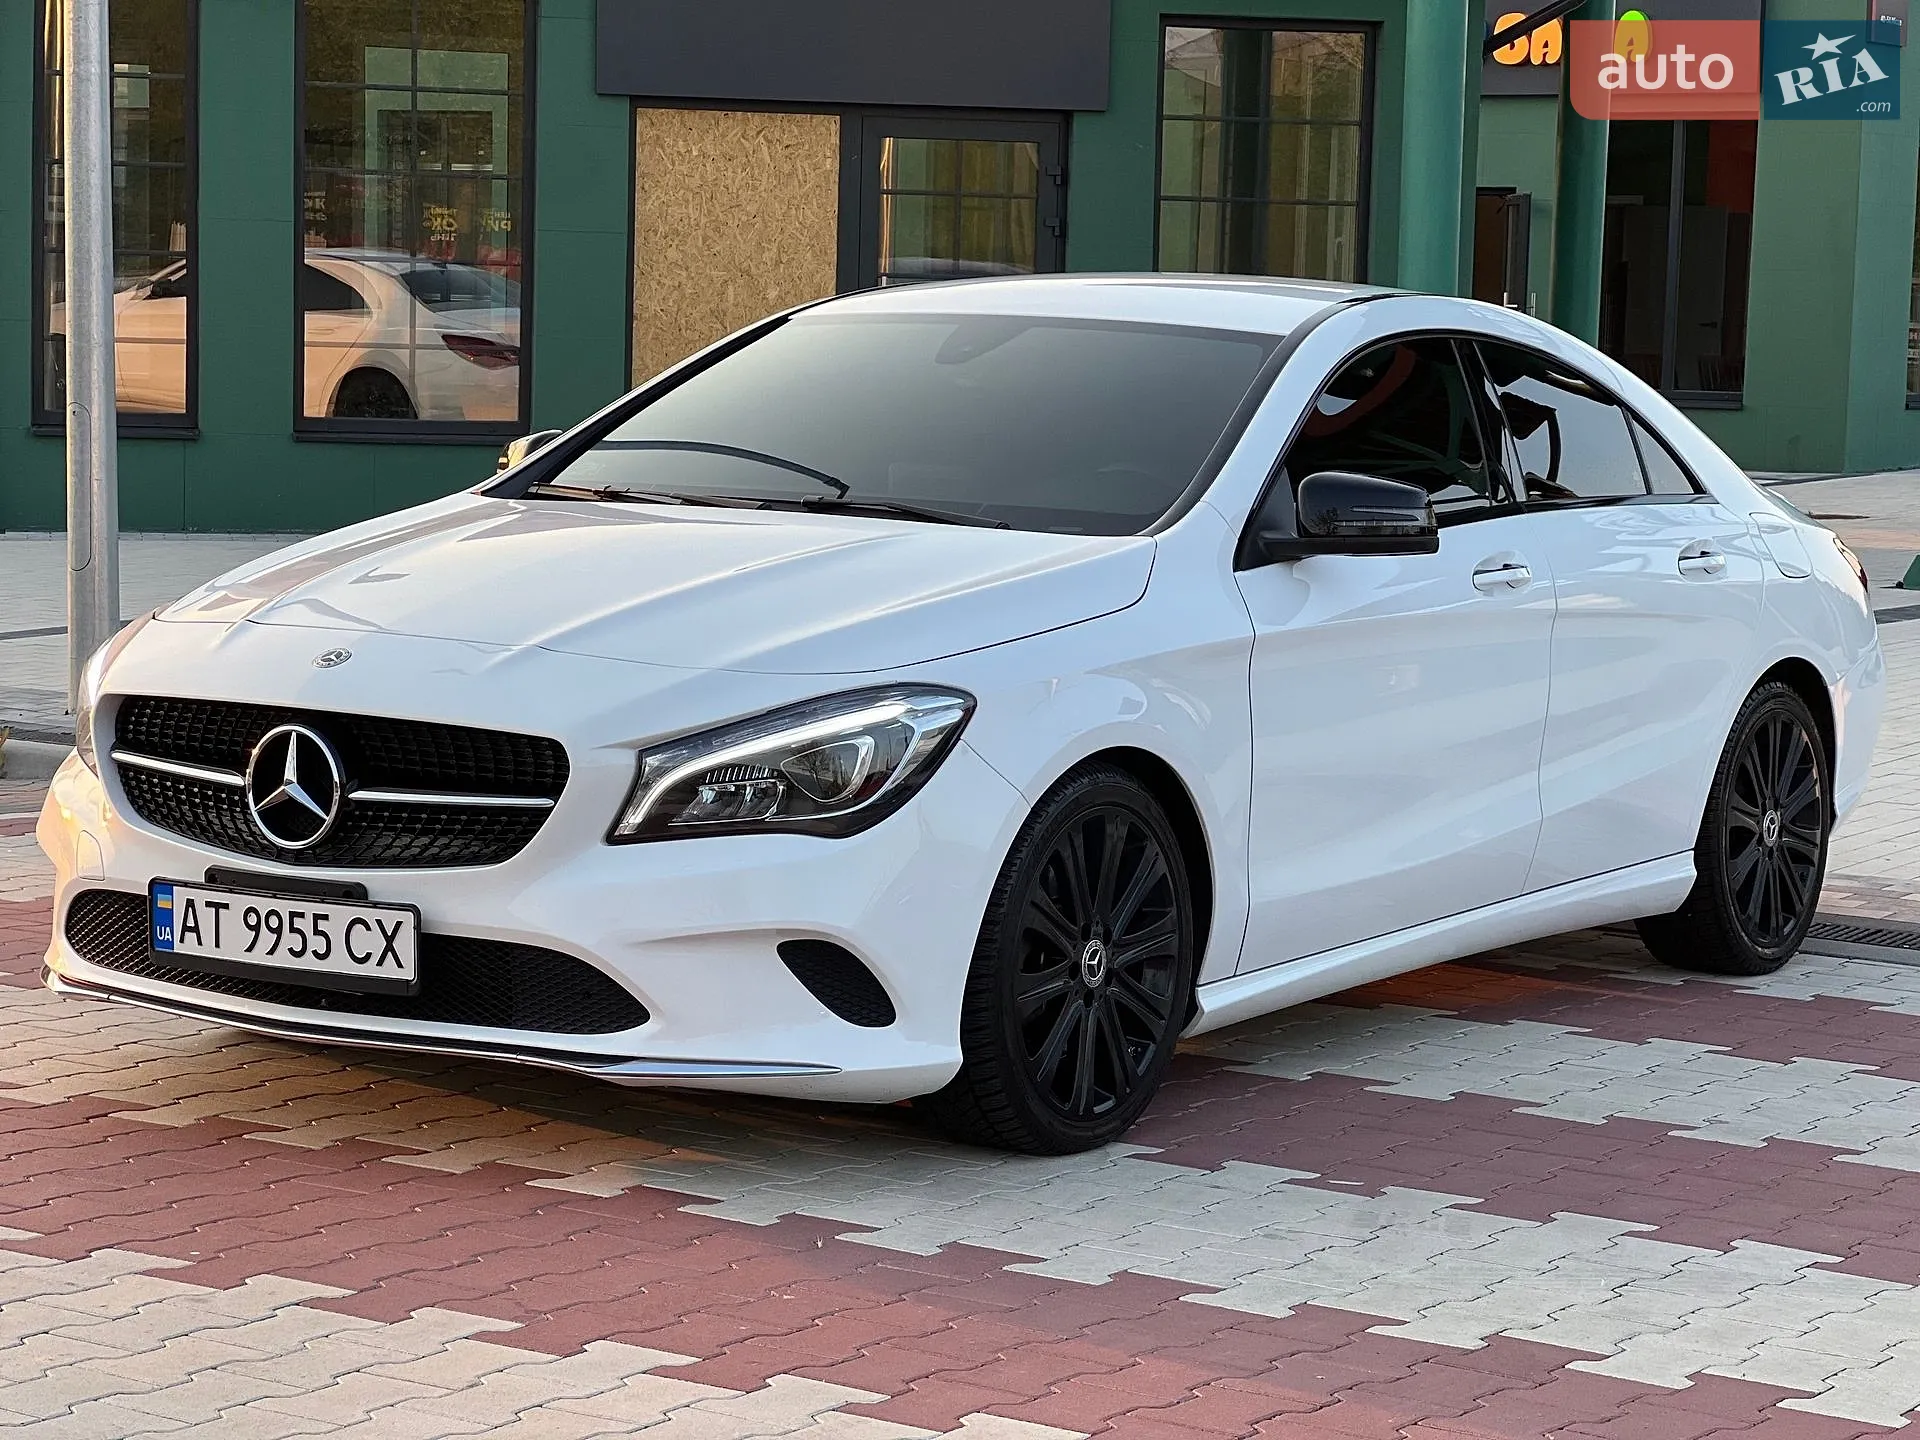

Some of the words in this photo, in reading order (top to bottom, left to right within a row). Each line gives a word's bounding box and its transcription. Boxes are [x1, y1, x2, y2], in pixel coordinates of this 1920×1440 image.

[157, 926, 172, 941] UA
[178, 897, 230, 948] AT
[242, 905, 332, 961] 9955
[344, 916, 405, 969] CX
